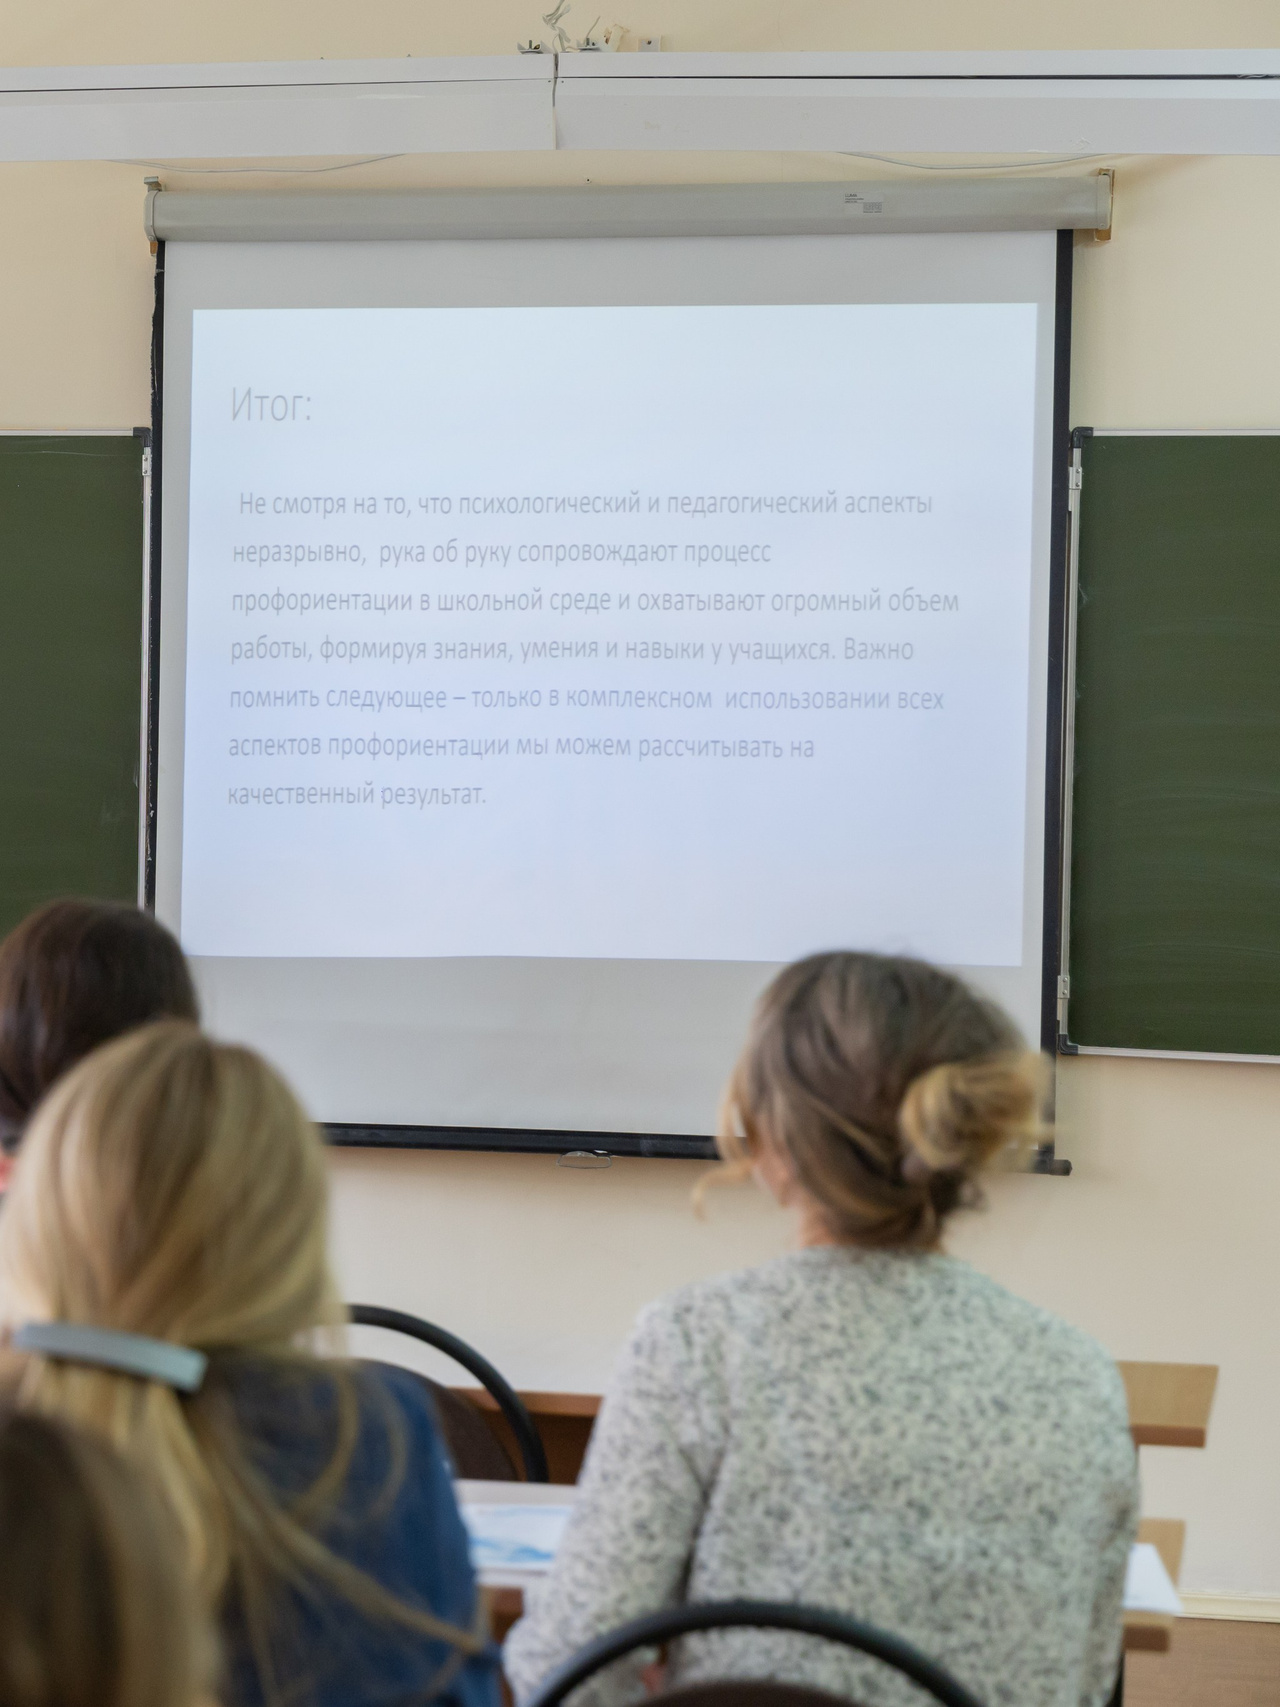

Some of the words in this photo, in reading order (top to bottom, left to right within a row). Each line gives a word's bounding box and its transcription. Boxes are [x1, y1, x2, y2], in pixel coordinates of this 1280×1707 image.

[231, 386, 312, 423] Итог:
[239, 491, 267, 516] Не
[272, 495, 347, 520] смотря
[353, 495, 378, 515] на
[382, 496, 412, 519] то,
[417, 495, 453, 515] что
[458, 489, 641, 515] психологический
[647, 496, 661, 514] и
[667, 489, 838, 519] педагогический
[844, 494, 933, 515] аспекты
[232, 543, 367, 568] неразрывно,
[379, 544, 426, 569] рука
[432, 537, 459, 564] об
[464, 544, 513, 569] руку
[517, 543, 679, 568] сопровождают
[684, 543, 772, 568] процесс
[231, 586, 413, 617] профориентации
[419, 592, 431, 612] в
[437, 586, 543, 612] школьной
[549, 591, 612, 616] среде
[617, 593, 631, 610] и
[636, 592, 766, 612] охватывают
[770, 587, 882, 617] огромный
[887, 585, 960, 613] объем
[230, 633, 313, 666] работы,
[319, 633, 428, 665] формируя
[433, 641, 514, 664] знания,
[519, 640, 599, 665] умения
[605, 641, 619, 659] и
[625, 640, 705, 661] навыки
[710, 642, 724, 666] у
[728, 641, 836, 666] учащихся.
[843, 636, 915, 661] Важно
[229, 689, 321, 709] помнить
[325, 688, 448, 714] следующее
[470, 688, 543, 709] только
[548, 688, 561, 707] в
[566, 688, 713, 710] комплексном
[725, 690, 891, 710] использовании
[897, 691, 945, 711] всех
[228, 736, 322, 758] аспектов
[328, 731, 510, 762] профориентации
[515, 737, 549, 756] мы
[555, 736, 632, 757] можем
[638, 738, 784, 763] рассчитывать
[790, 739, 815, 759] на
[227, 780, 375, 806] качественный
[380, 786, 487, 811] результат.
